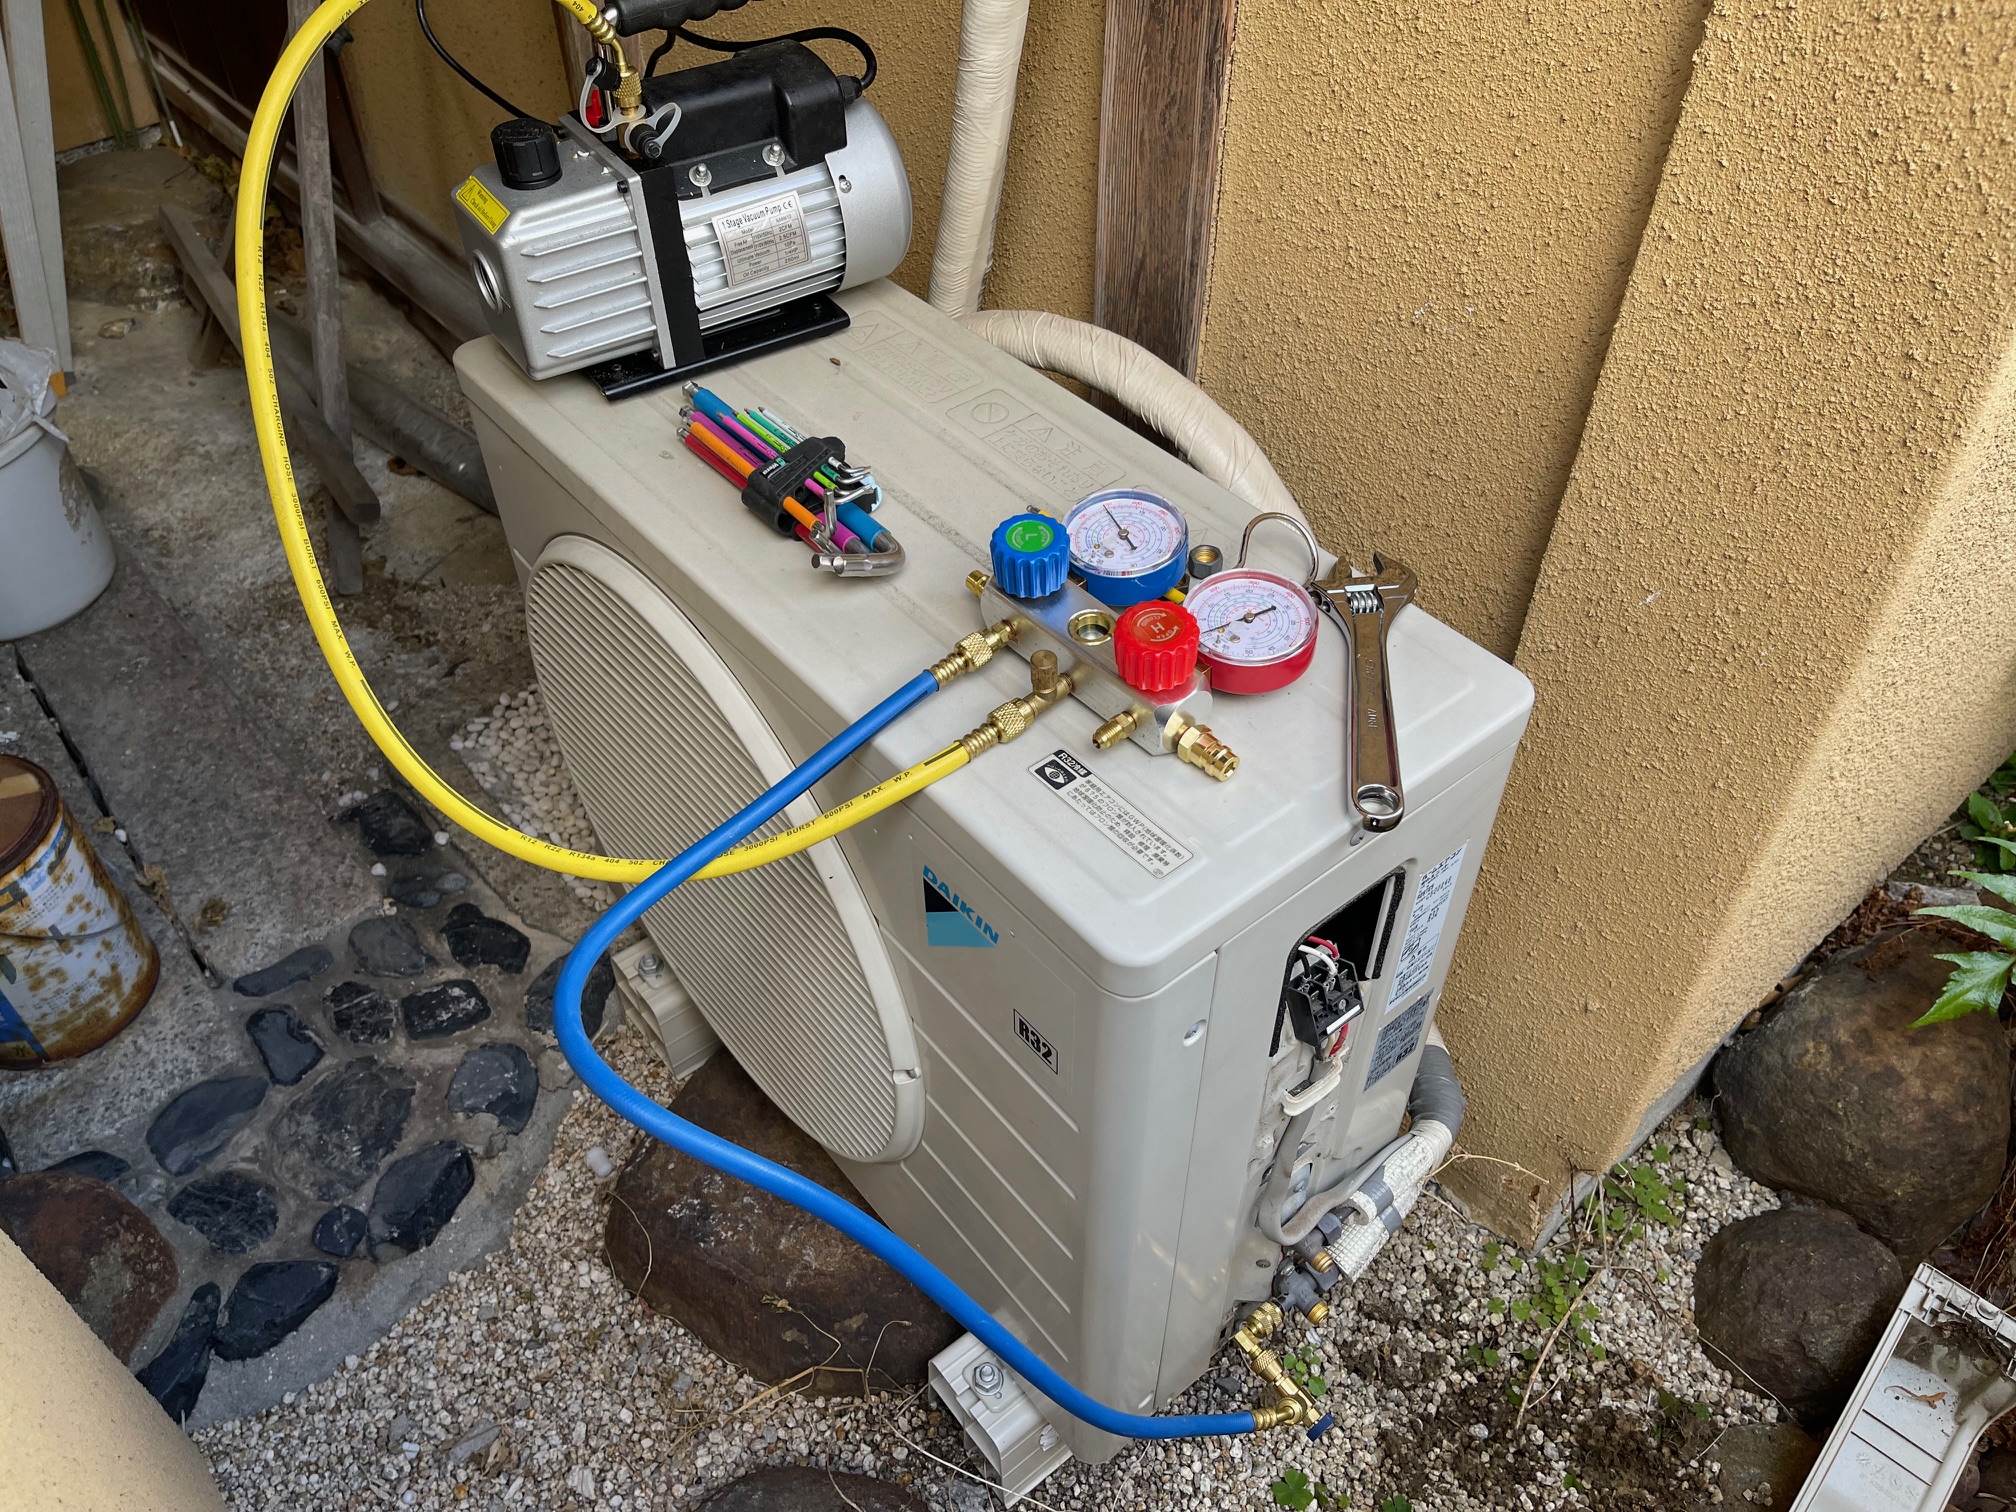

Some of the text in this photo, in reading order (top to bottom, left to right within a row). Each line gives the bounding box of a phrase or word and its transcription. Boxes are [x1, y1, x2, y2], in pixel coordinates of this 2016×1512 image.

[572, 1, 585, 12] 404
[726, 217, 743, 228] Stage
[742, 209, 765, 223] Vacuum
[764, 204, 782, 216] Pump
[730, 244, 754, 256] Displacement
[737, 249, 771, 263] Ultimate Vacuum
[749, 260, 762, 268] Power
[750, 265, 770, 276] Capacity
[1004, 430, 1095, 490] ケガのおそれあり
[762, 462, 780, 475] Wera
[271, 394, 286, 447] CHARGING
[283, 456, 293, 483] HOSE
[291, 492, 305, 530] 3000PSI
[303, 538, 318, 570] BURST
[316, 579, 331, 610] 600PSI
[331, 620, 343, 643] MAX.
[344, 650, 356, 669] W.P.
[1150, 621, 1165, 634] H
[1156, 629, 1173, 639] OPEN
[1058, 752, 1088, 776] R32冷媒
[743, 835, 779, 852] 3000PSI
[786, 819, 816, 837] BURST
[824, 801, 854, 820] 600PSI
[862, 785, 886, 800] MAX.
[893, 770, 913, 783] W.P.
[519, 834, 538, 845] R12
[543, 844, 562, 853] R22
[568, 851, 596, 861] R134a
[922, 864, 999, 945] DAIKIN
[1426, 908, 1440, 923] R32
[1018, 1017, 1053, 1065] R32
